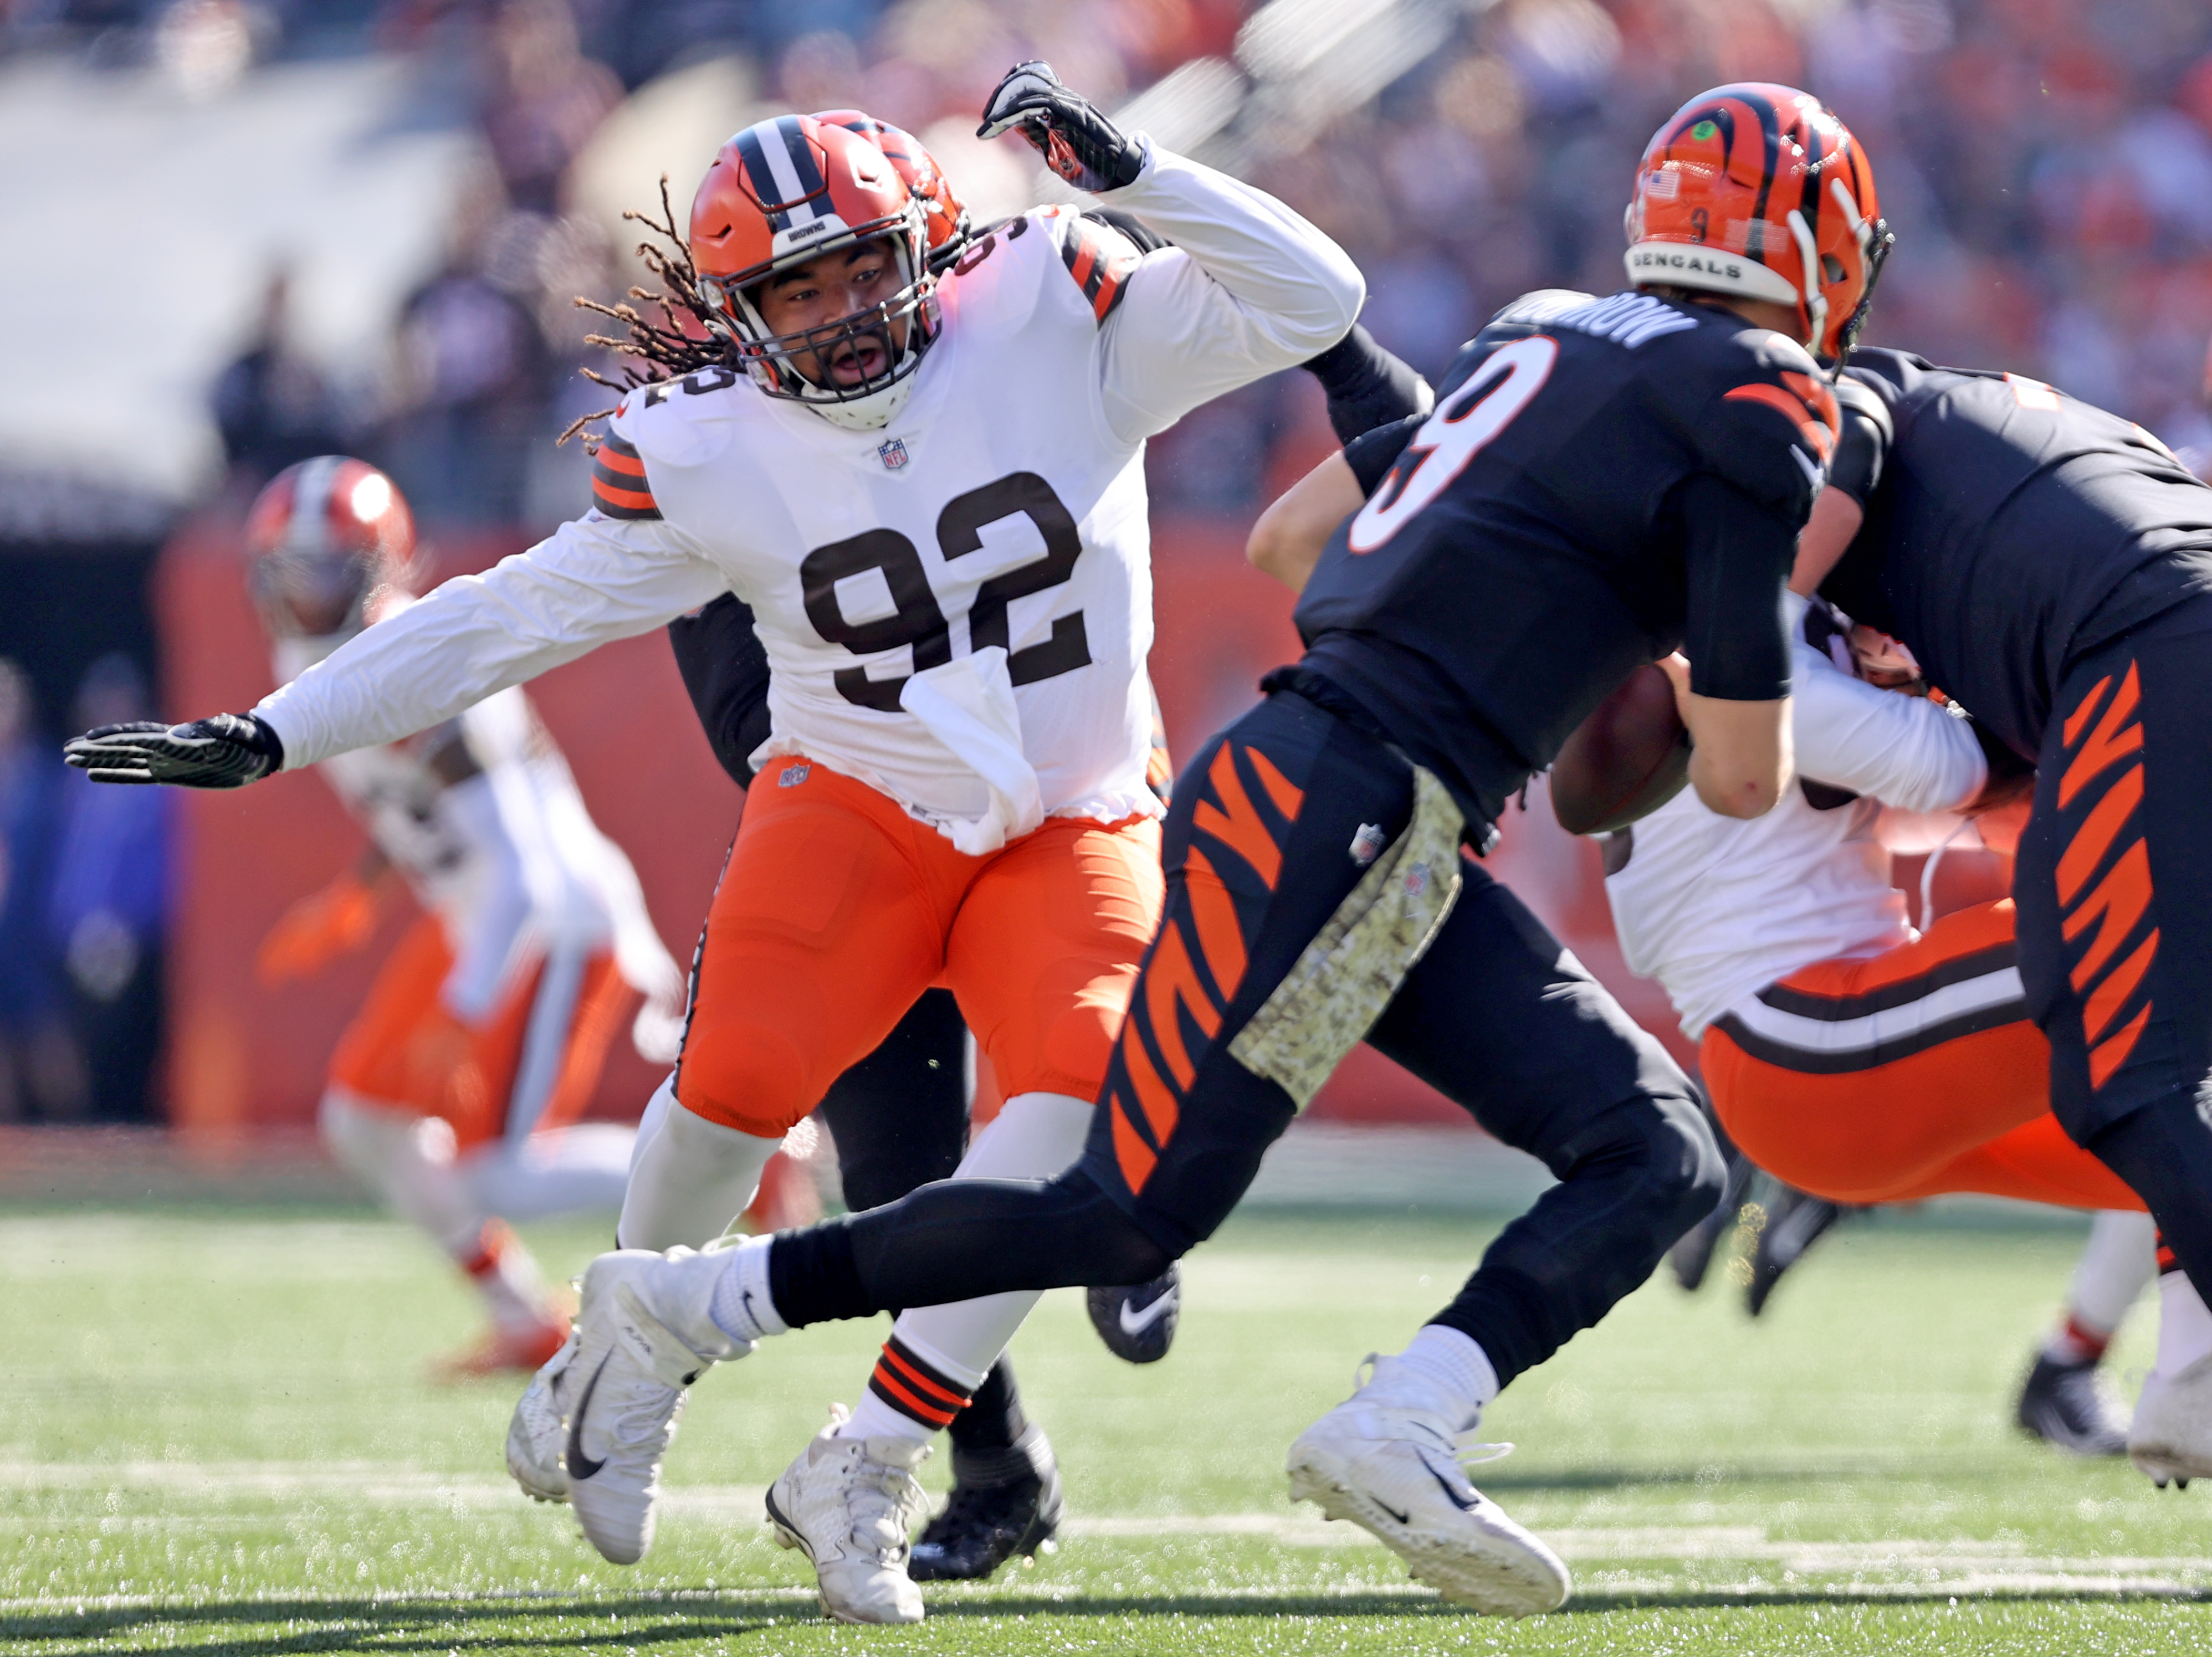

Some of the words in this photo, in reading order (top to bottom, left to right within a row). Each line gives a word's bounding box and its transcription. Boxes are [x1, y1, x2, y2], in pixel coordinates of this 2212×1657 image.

[788, 220, 826, 242] BROWNS
[1692, 207, 1709, 243] 9
[1634, 252, 1741, 278] BENGALS
[884, 449, 907, 466] NFL
[1348, 334, 1560, 555] 9
[800, 470, 1093, 712] 92
